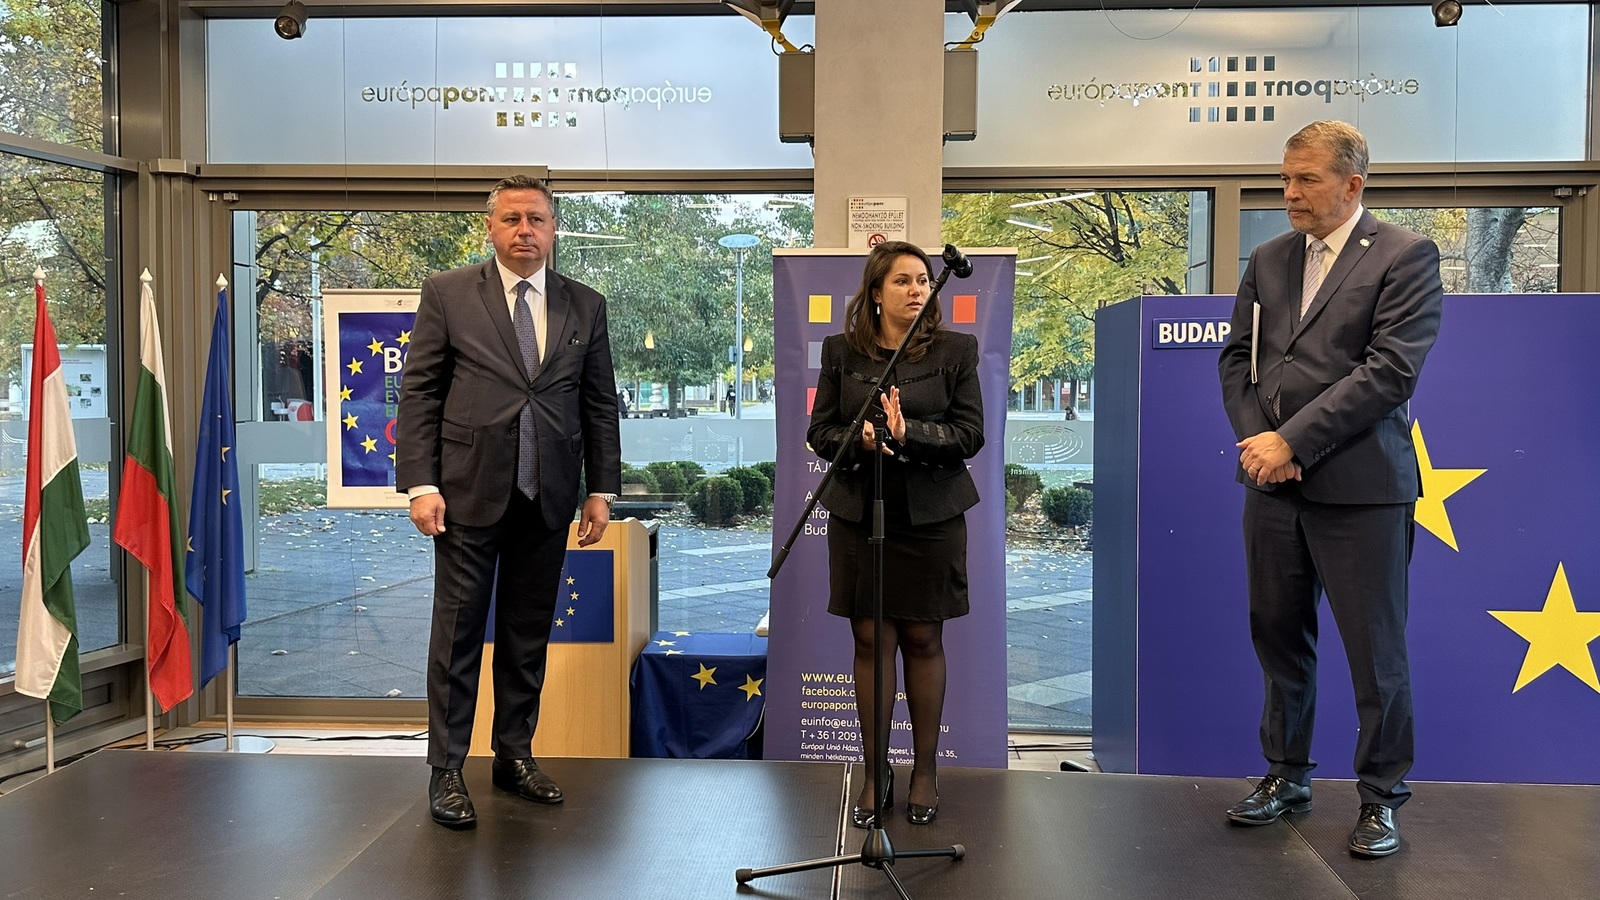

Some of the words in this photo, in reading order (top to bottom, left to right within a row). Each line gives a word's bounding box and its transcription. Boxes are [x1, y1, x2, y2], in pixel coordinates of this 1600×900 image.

[361, 80, 507, 109] európapont
[1159, 322, 1232, 344] BUDAP
[804, 523, 828, 536] Bud
[801, 672, 856, 684] www.eu.
[802, 685, 856, 697] facebook.c
[800, 717, 861, 728] euinfo@eu.h
[800, 730, 807, 739] T
[838, 731, 857, 741] 209
